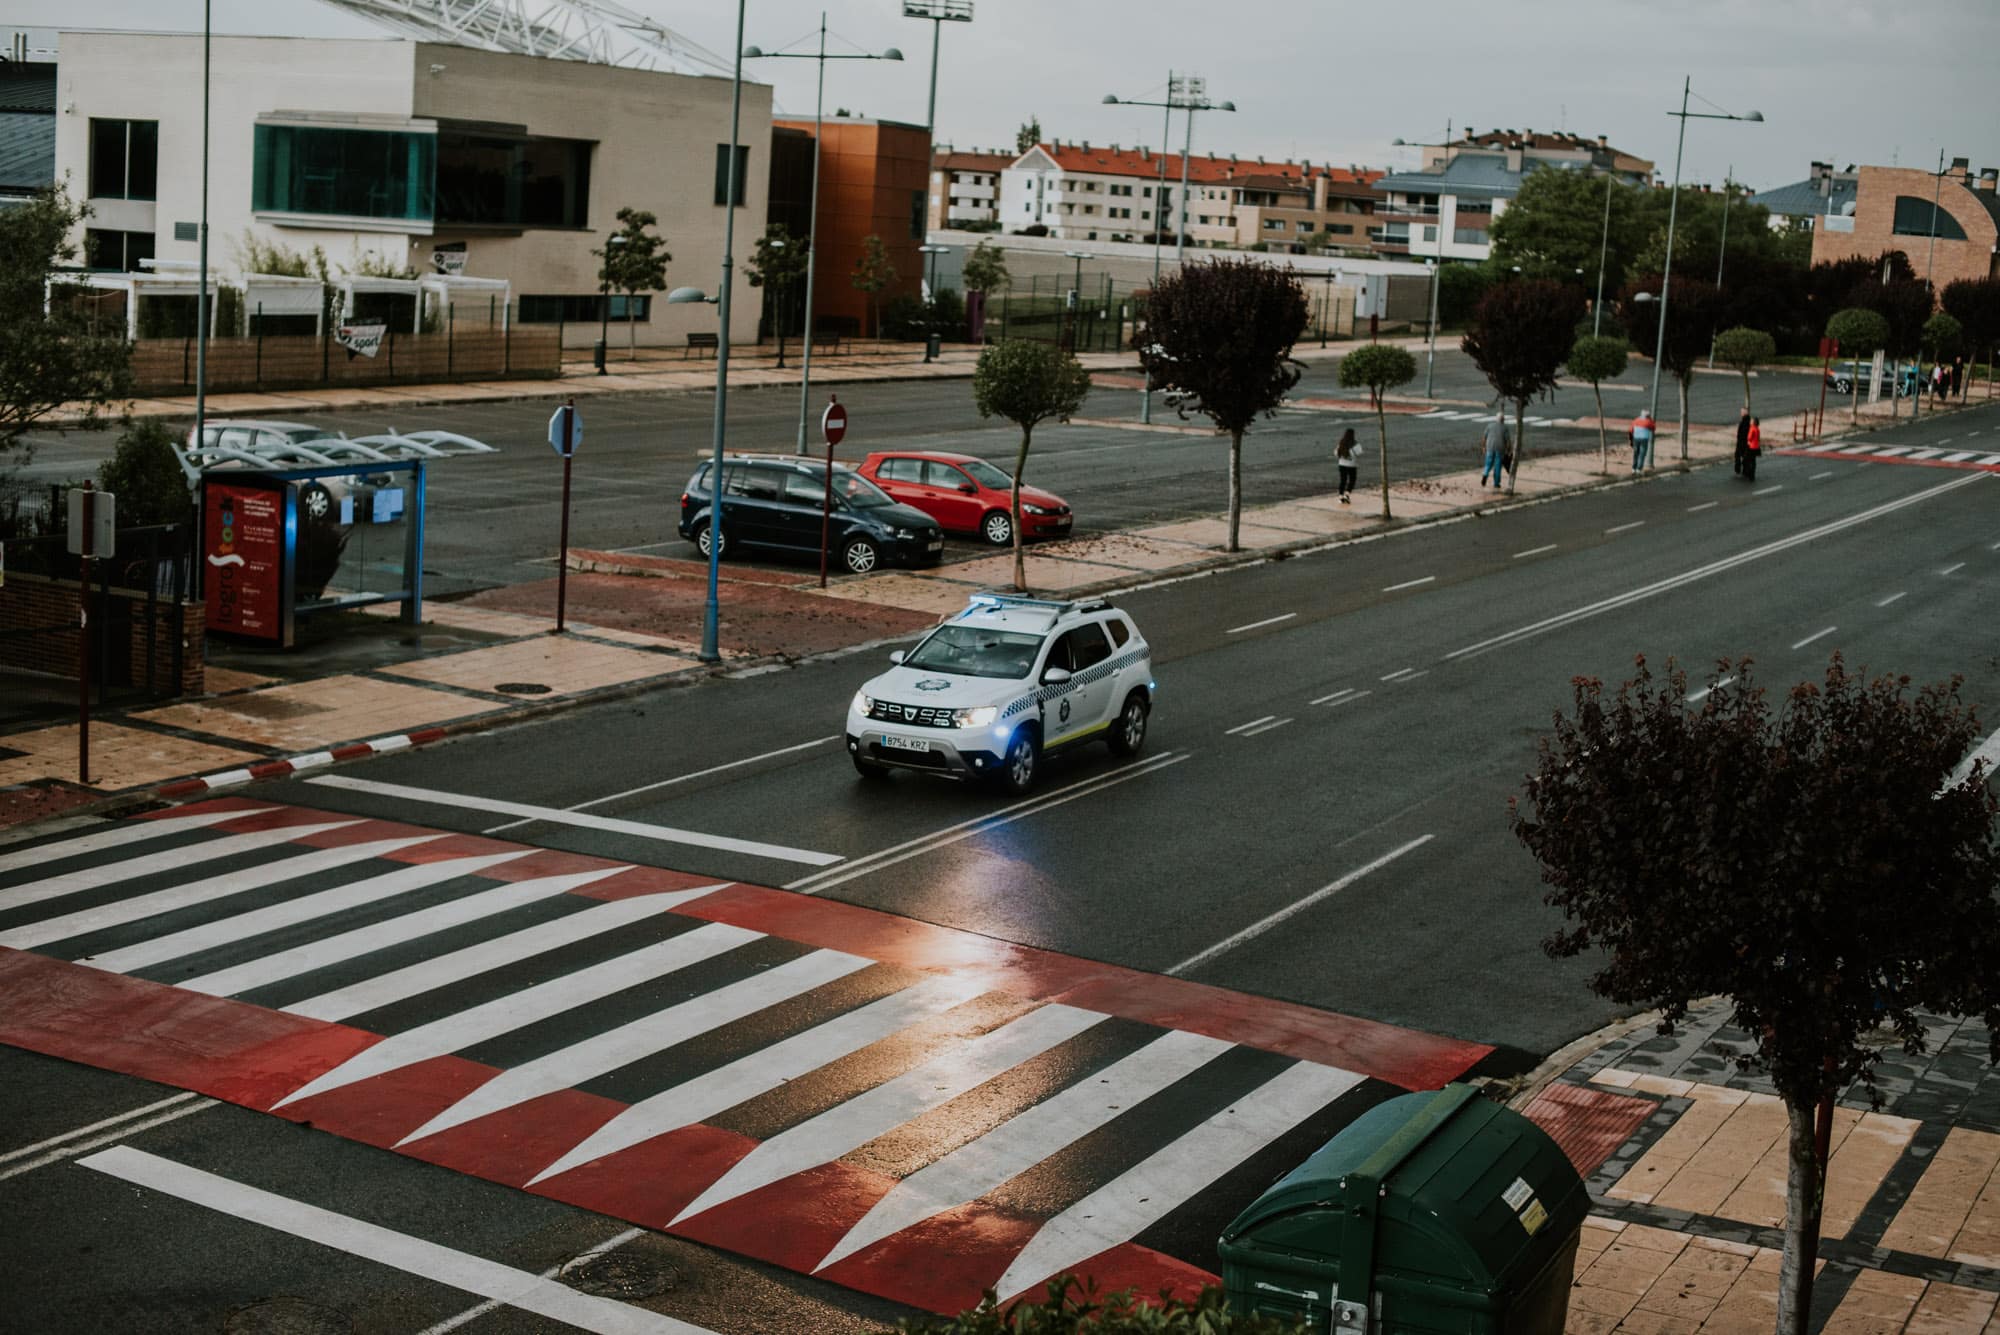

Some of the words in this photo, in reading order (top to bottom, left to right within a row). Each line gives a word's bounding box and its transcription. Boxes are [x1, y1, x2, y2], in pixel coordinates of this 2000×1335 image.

[354, 336, 379, 350] sport
[887, 736, 907, 748] 8754
[910, 740, 927, 750] KRZ
